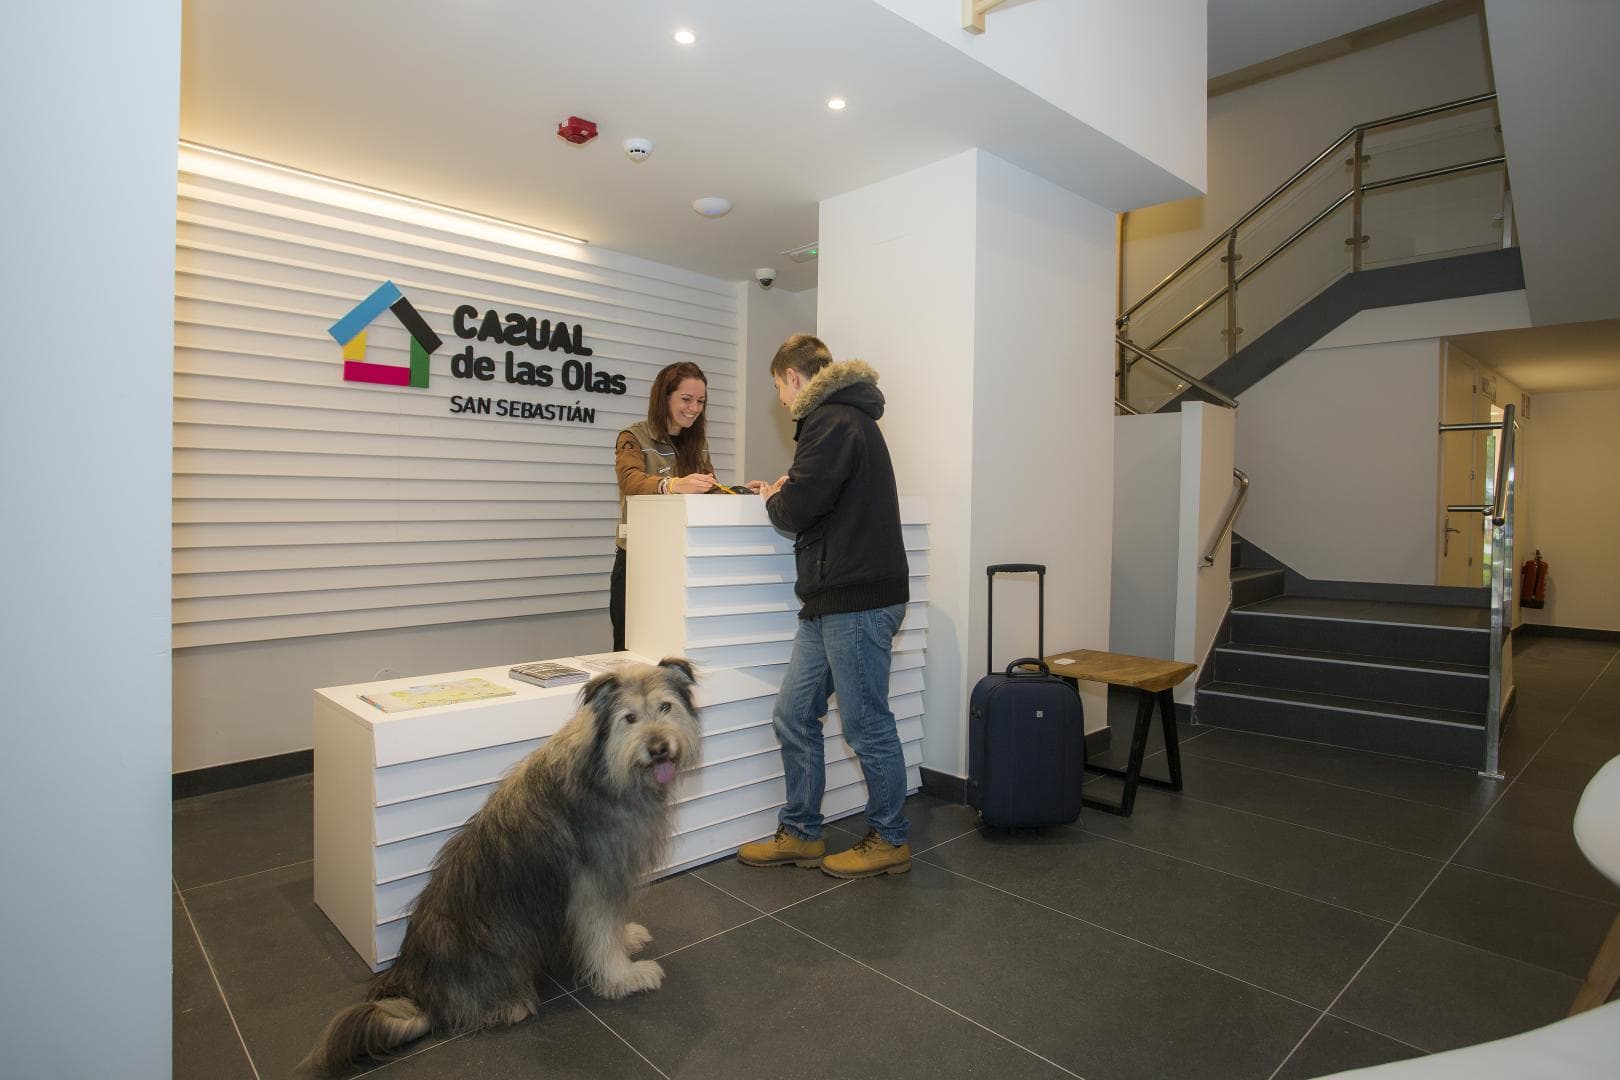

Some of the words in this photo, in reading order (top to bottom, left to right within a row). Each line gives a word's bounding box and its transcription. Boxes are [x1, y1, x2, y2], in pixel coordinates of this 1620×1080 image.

[453, 304, 593, 356] CASUAL
[450, 345, 495, 380] de
[505, 350, 553, 387] las
[561, 359, 627, 395] Olas
[450, 396, 491, 414] SAN
[495, 399, 596, 424] SEBASTIÁN
